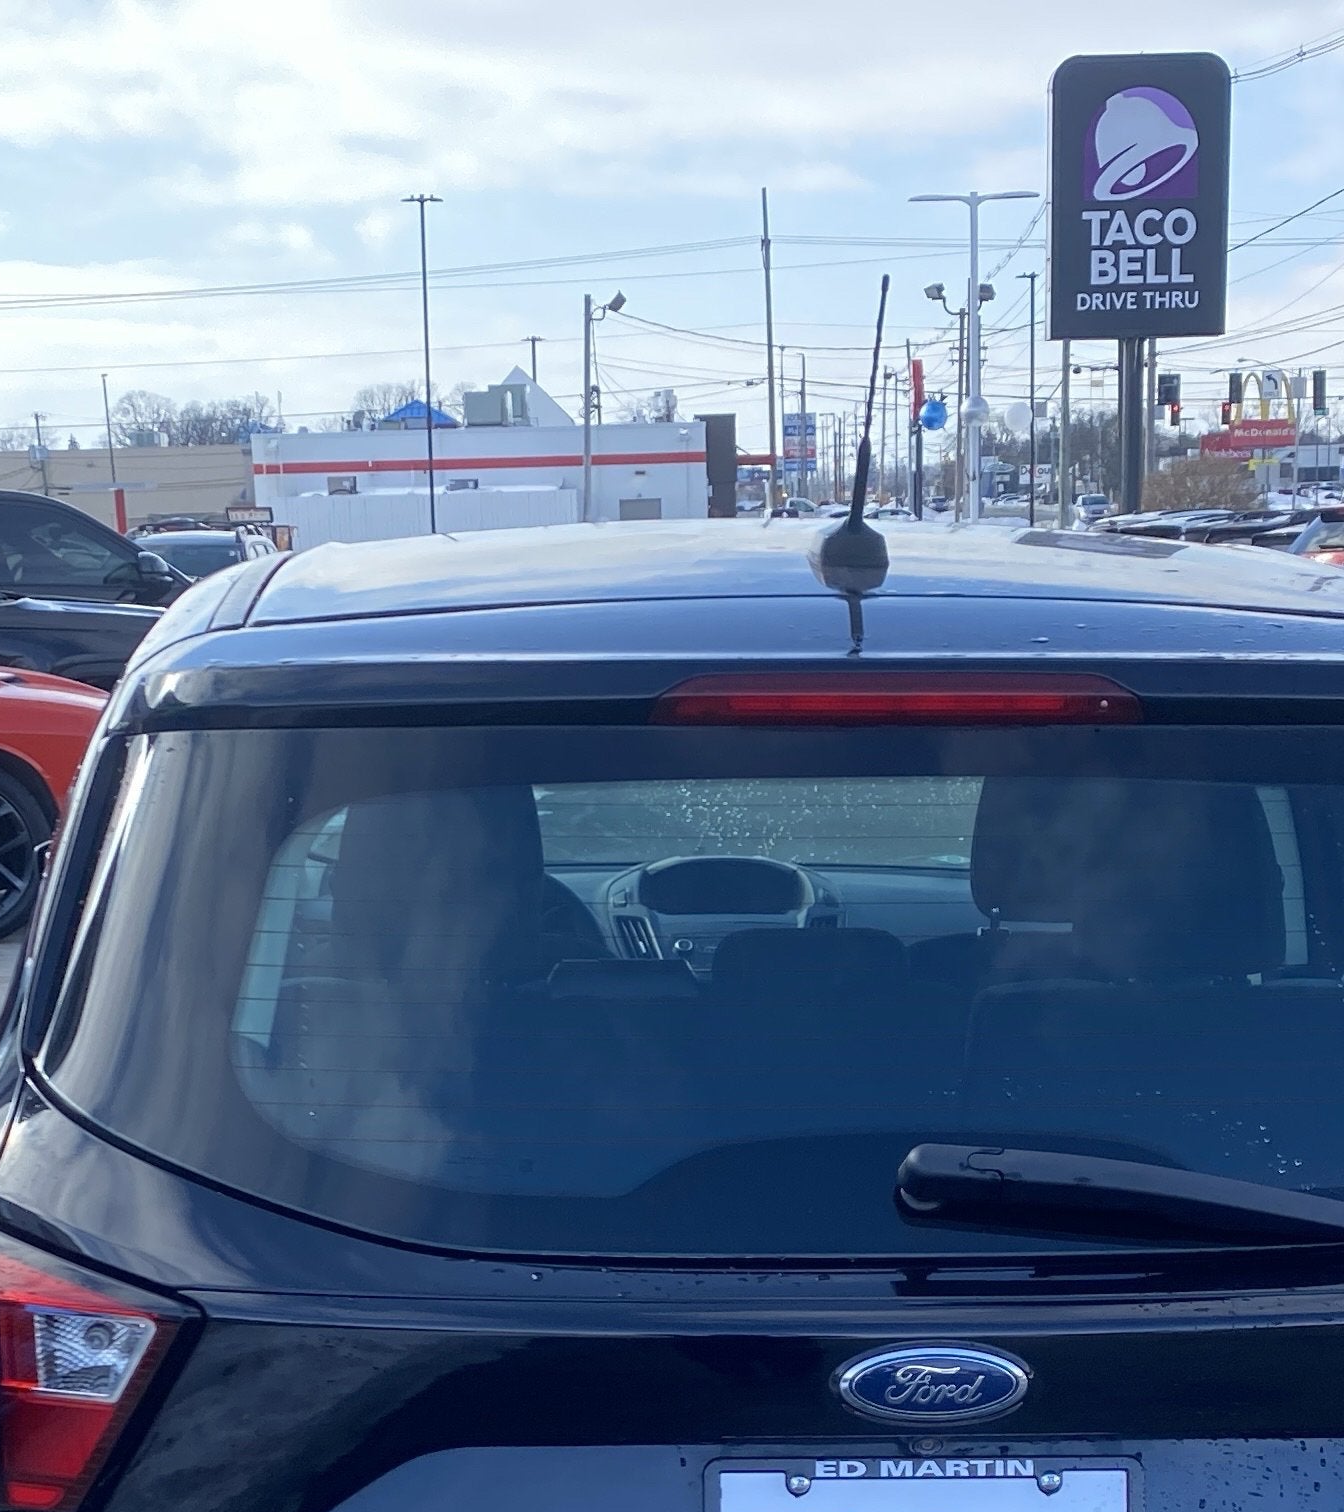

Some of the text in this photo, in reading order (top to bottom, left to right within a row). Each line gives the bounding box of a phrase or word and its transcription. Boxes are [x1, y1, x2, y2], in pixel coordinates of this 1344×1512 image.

[1081, 207, 1197, 246] TACO
[1090, 248, 1194, 285] BELL
[1076, 290, 1200, 311] DRIVE THRU
[884, 1365, 985, 1405] Ford
[814, 1459, 1035, 1478] ED MARTIN
